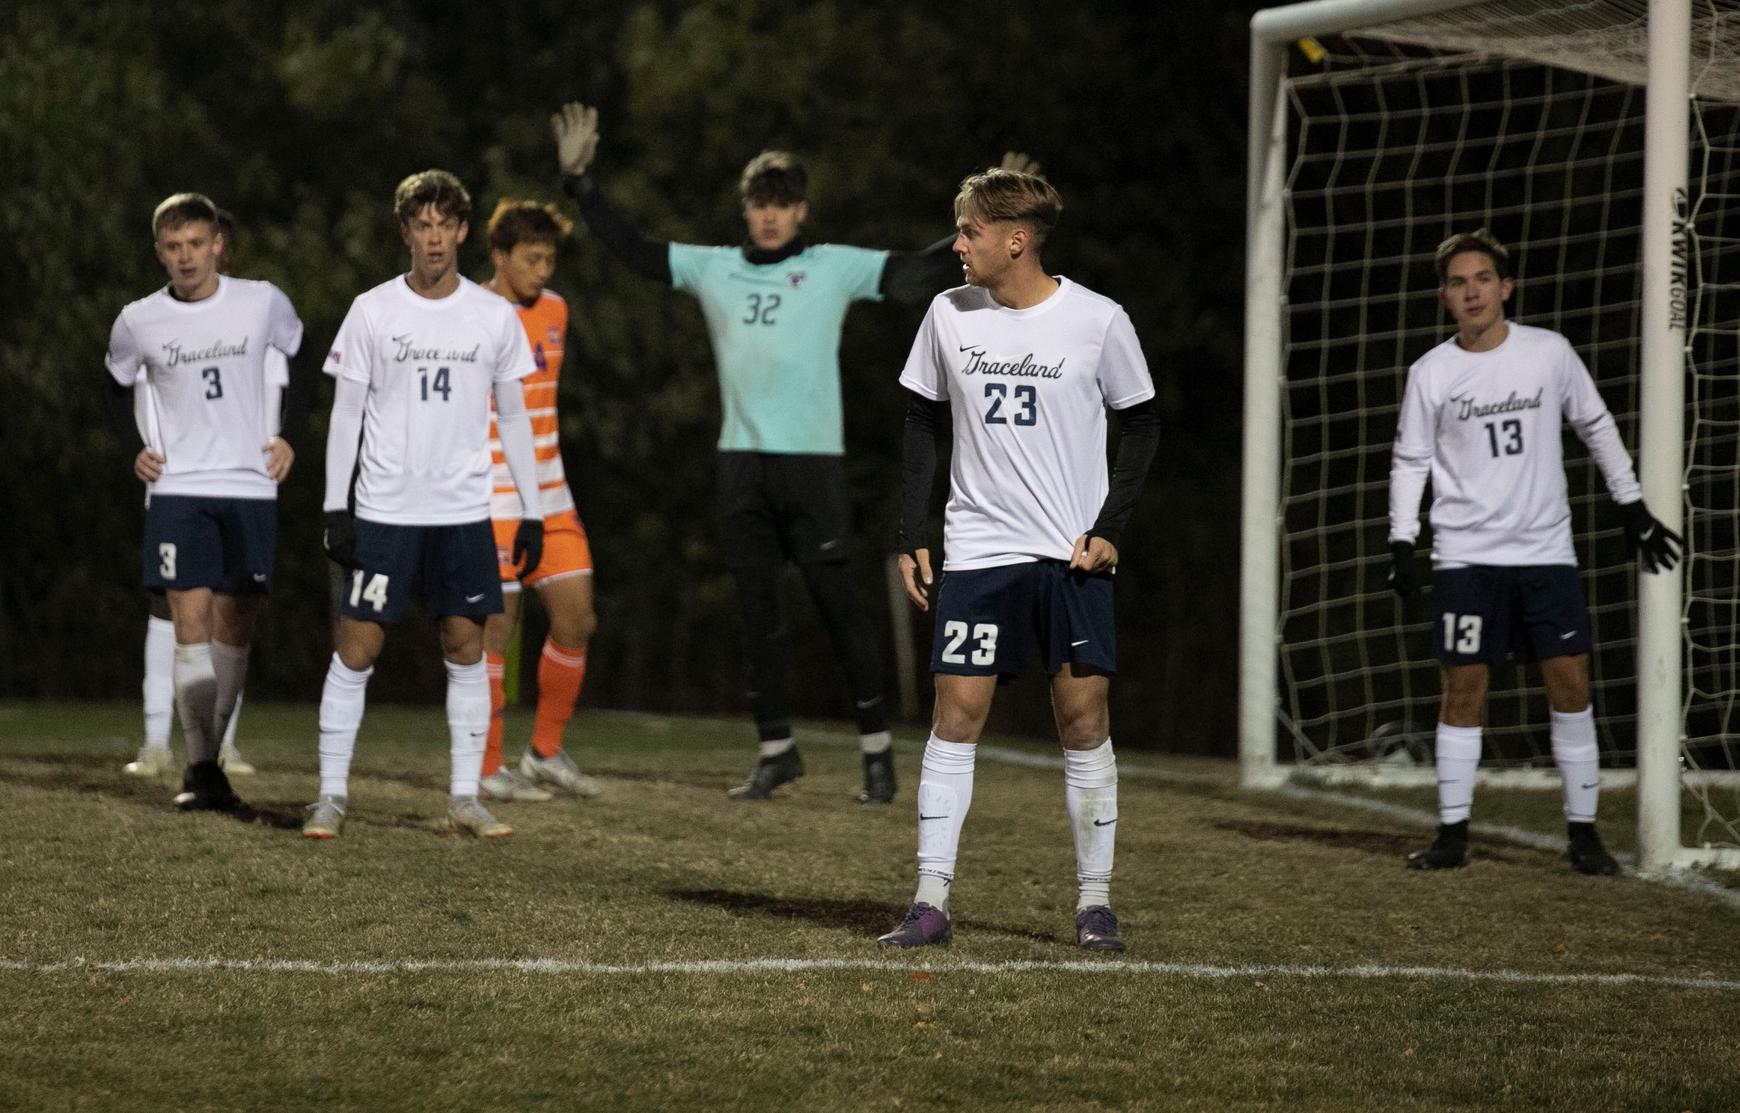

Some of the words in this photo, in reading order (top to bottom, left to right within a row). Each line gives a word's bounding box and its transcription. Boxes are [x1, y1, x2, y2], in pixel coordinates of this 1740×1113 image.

[743, 293, 782, 325] 32
[202, 367, 223, 400] 3
[417, 367, 452, 402] 14
[984, 382, 1037, 427] 23
[1484, 419, 1524, 458] 13
[159, 542, 177, 579] 3
[349, 569, 389, 612] 14
[941, 620, 999, 666] 23
[1442, 612, 1483, 654] 13
